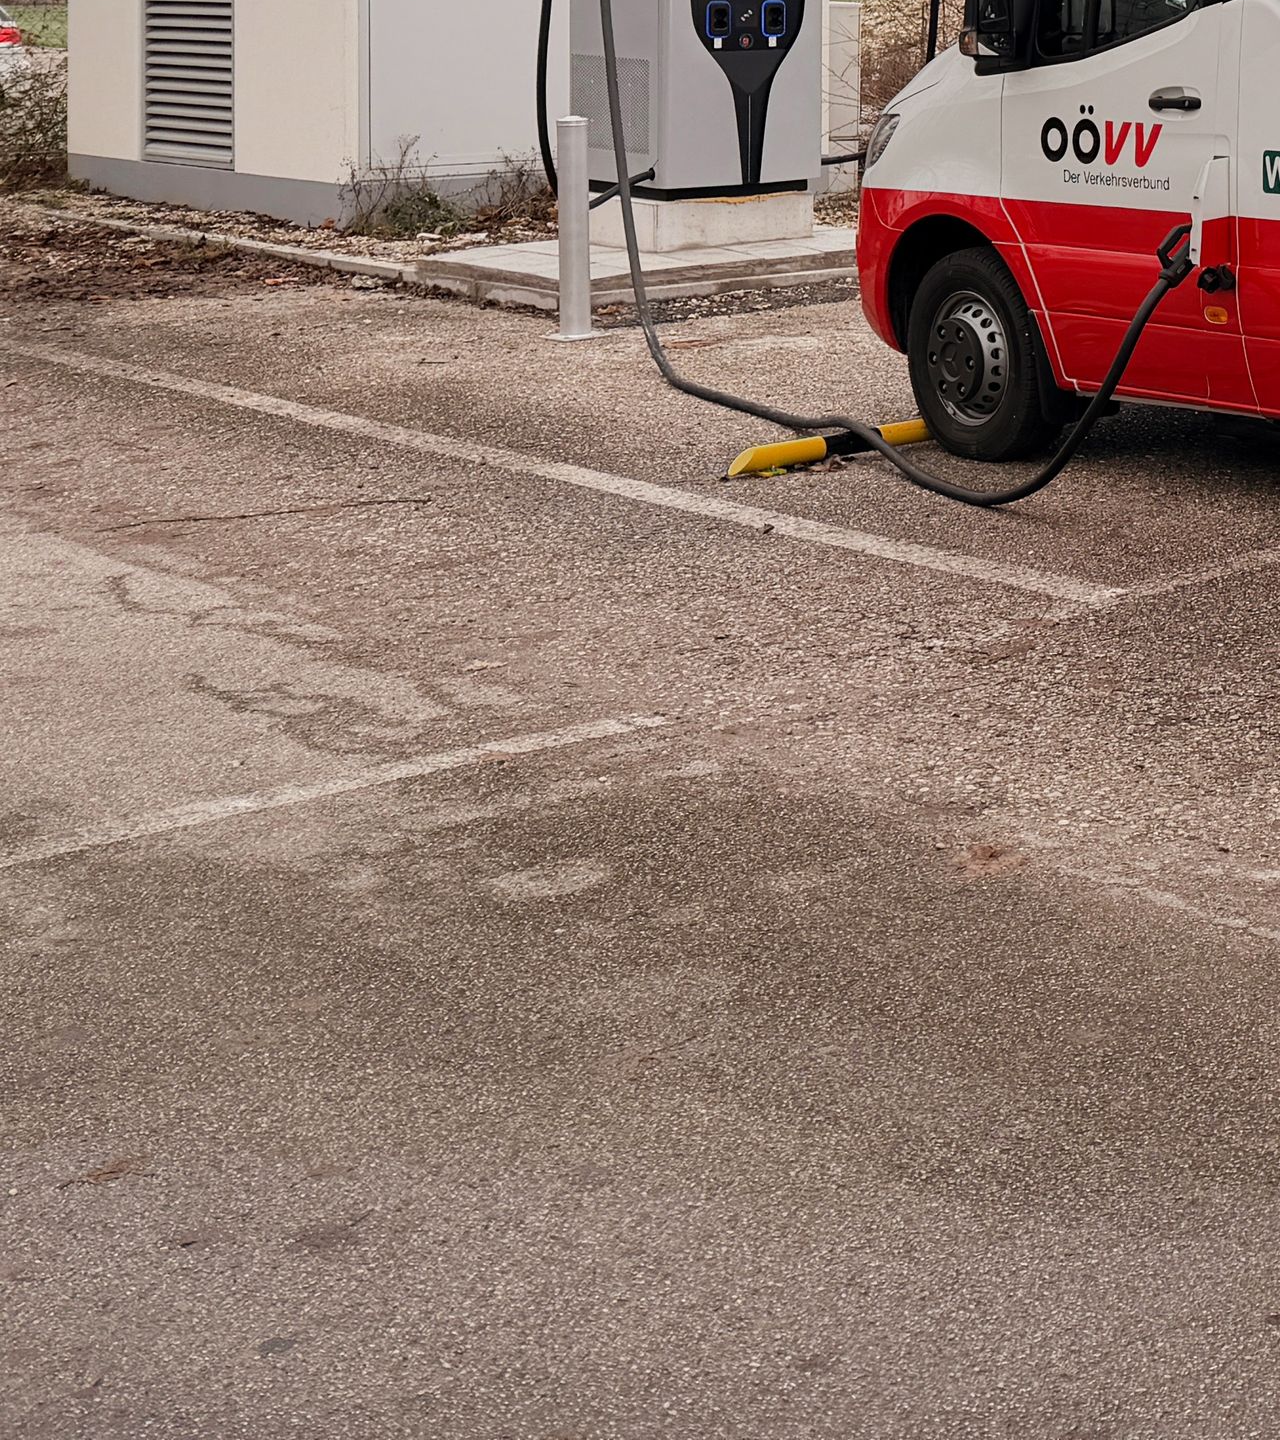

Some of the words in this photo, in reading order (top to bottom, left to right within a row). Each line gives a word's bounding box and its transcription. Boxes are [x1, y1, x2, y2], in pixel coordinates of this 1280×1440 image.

[1040, 104, 1163, 168] OÖVV
[1063, 169, 1081, 185] Der
[1083, 170, 1170, 191] Verkehrsverbund
